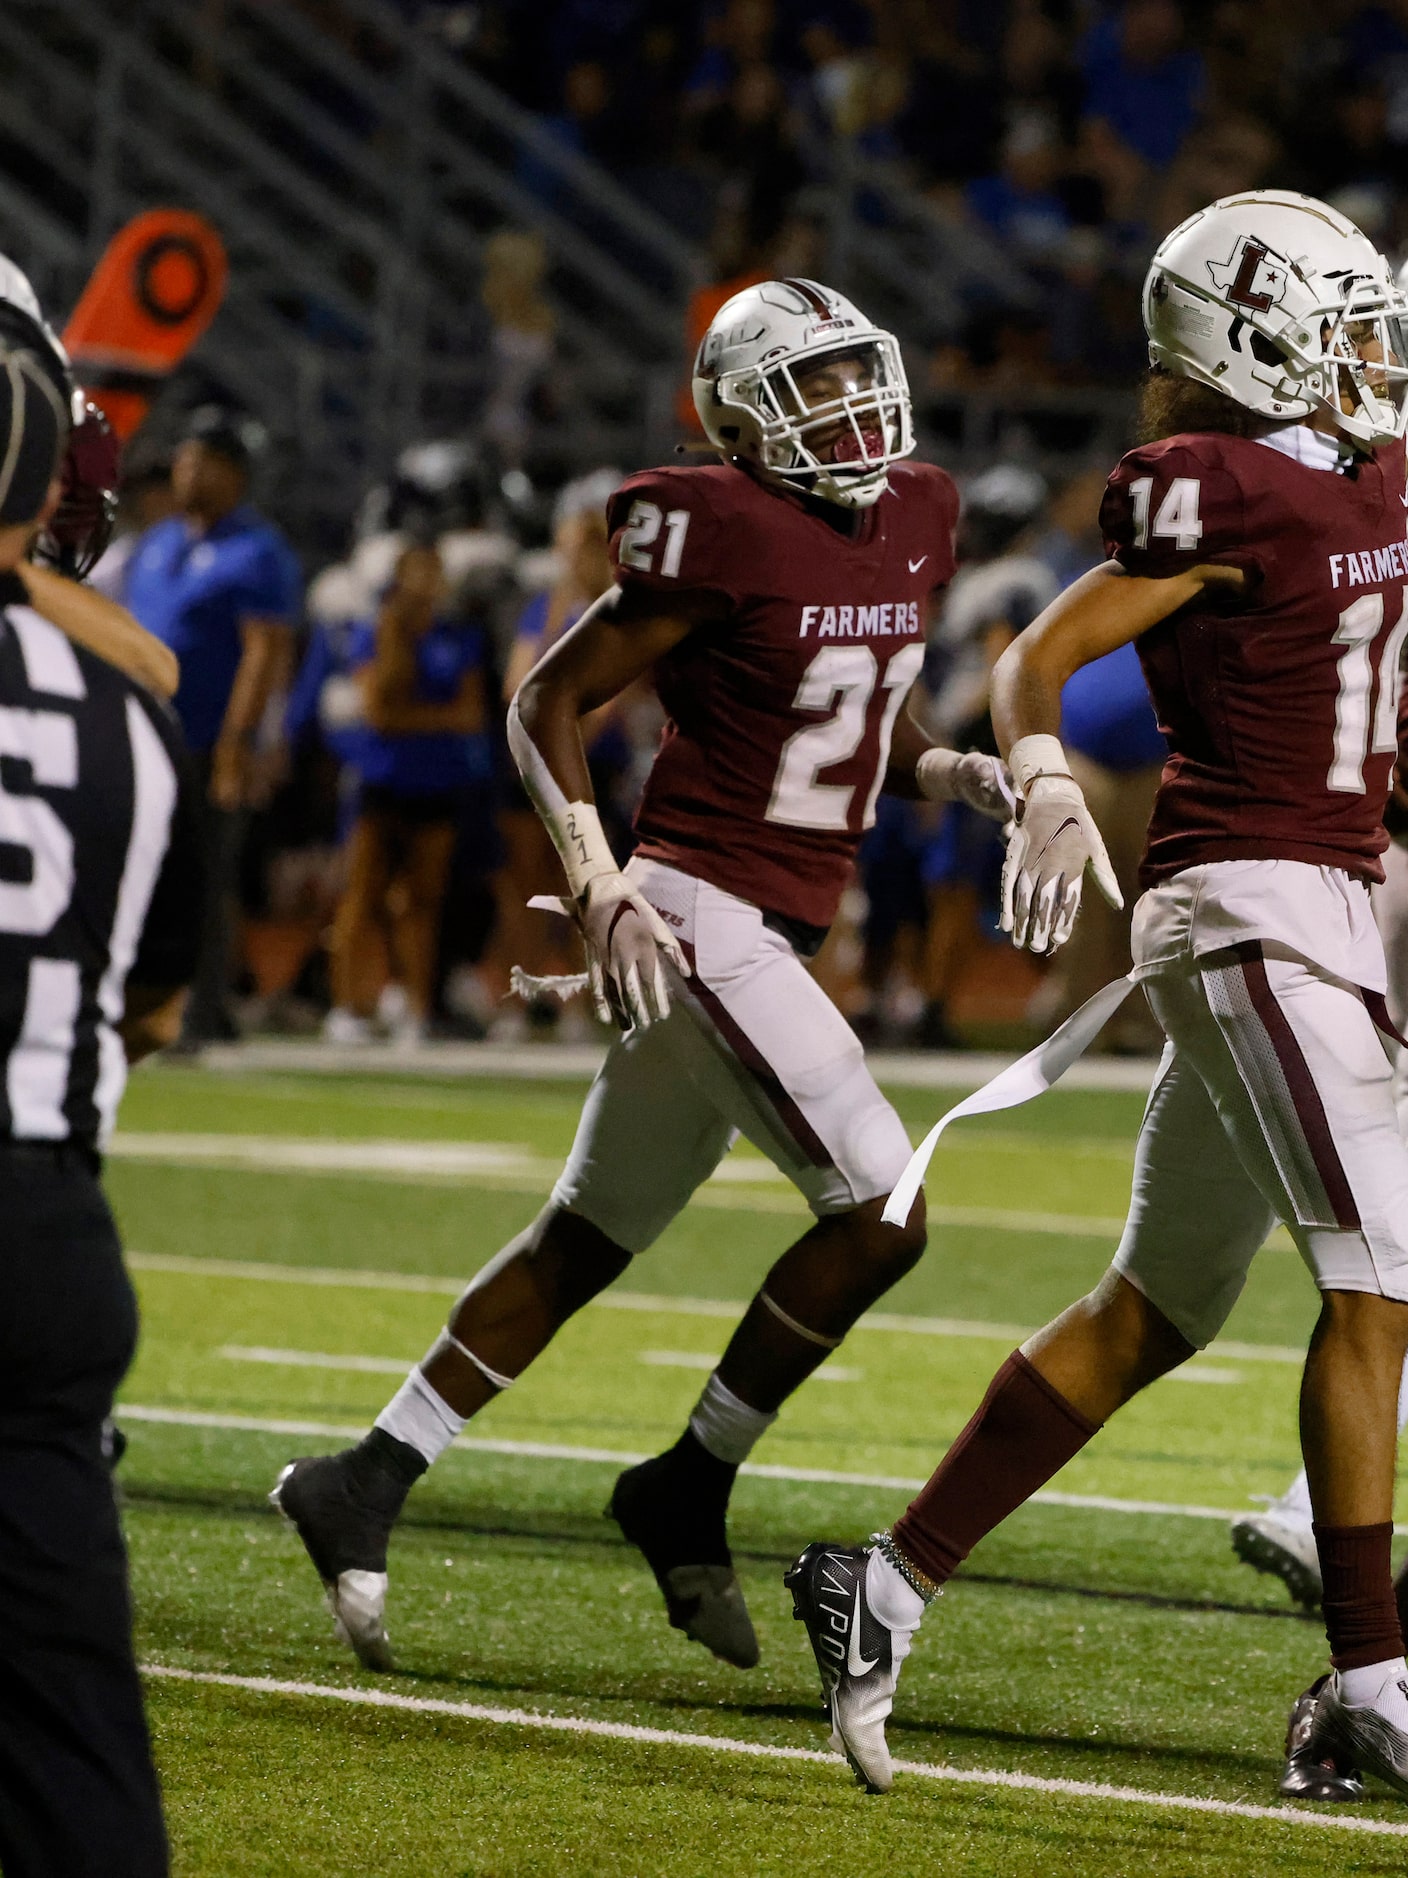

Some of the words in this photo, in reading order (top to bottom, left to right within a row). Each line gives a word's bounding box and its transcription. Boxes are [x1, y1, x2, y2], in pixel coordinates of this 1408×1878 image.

[1226, 241, 1273, 314] L
[618, 499, 692, 578] 21
[1128, 476, 1203, 551] 14
[799, 601, 919, 638] FARMERS
[763, 642, 926, 831] 21
